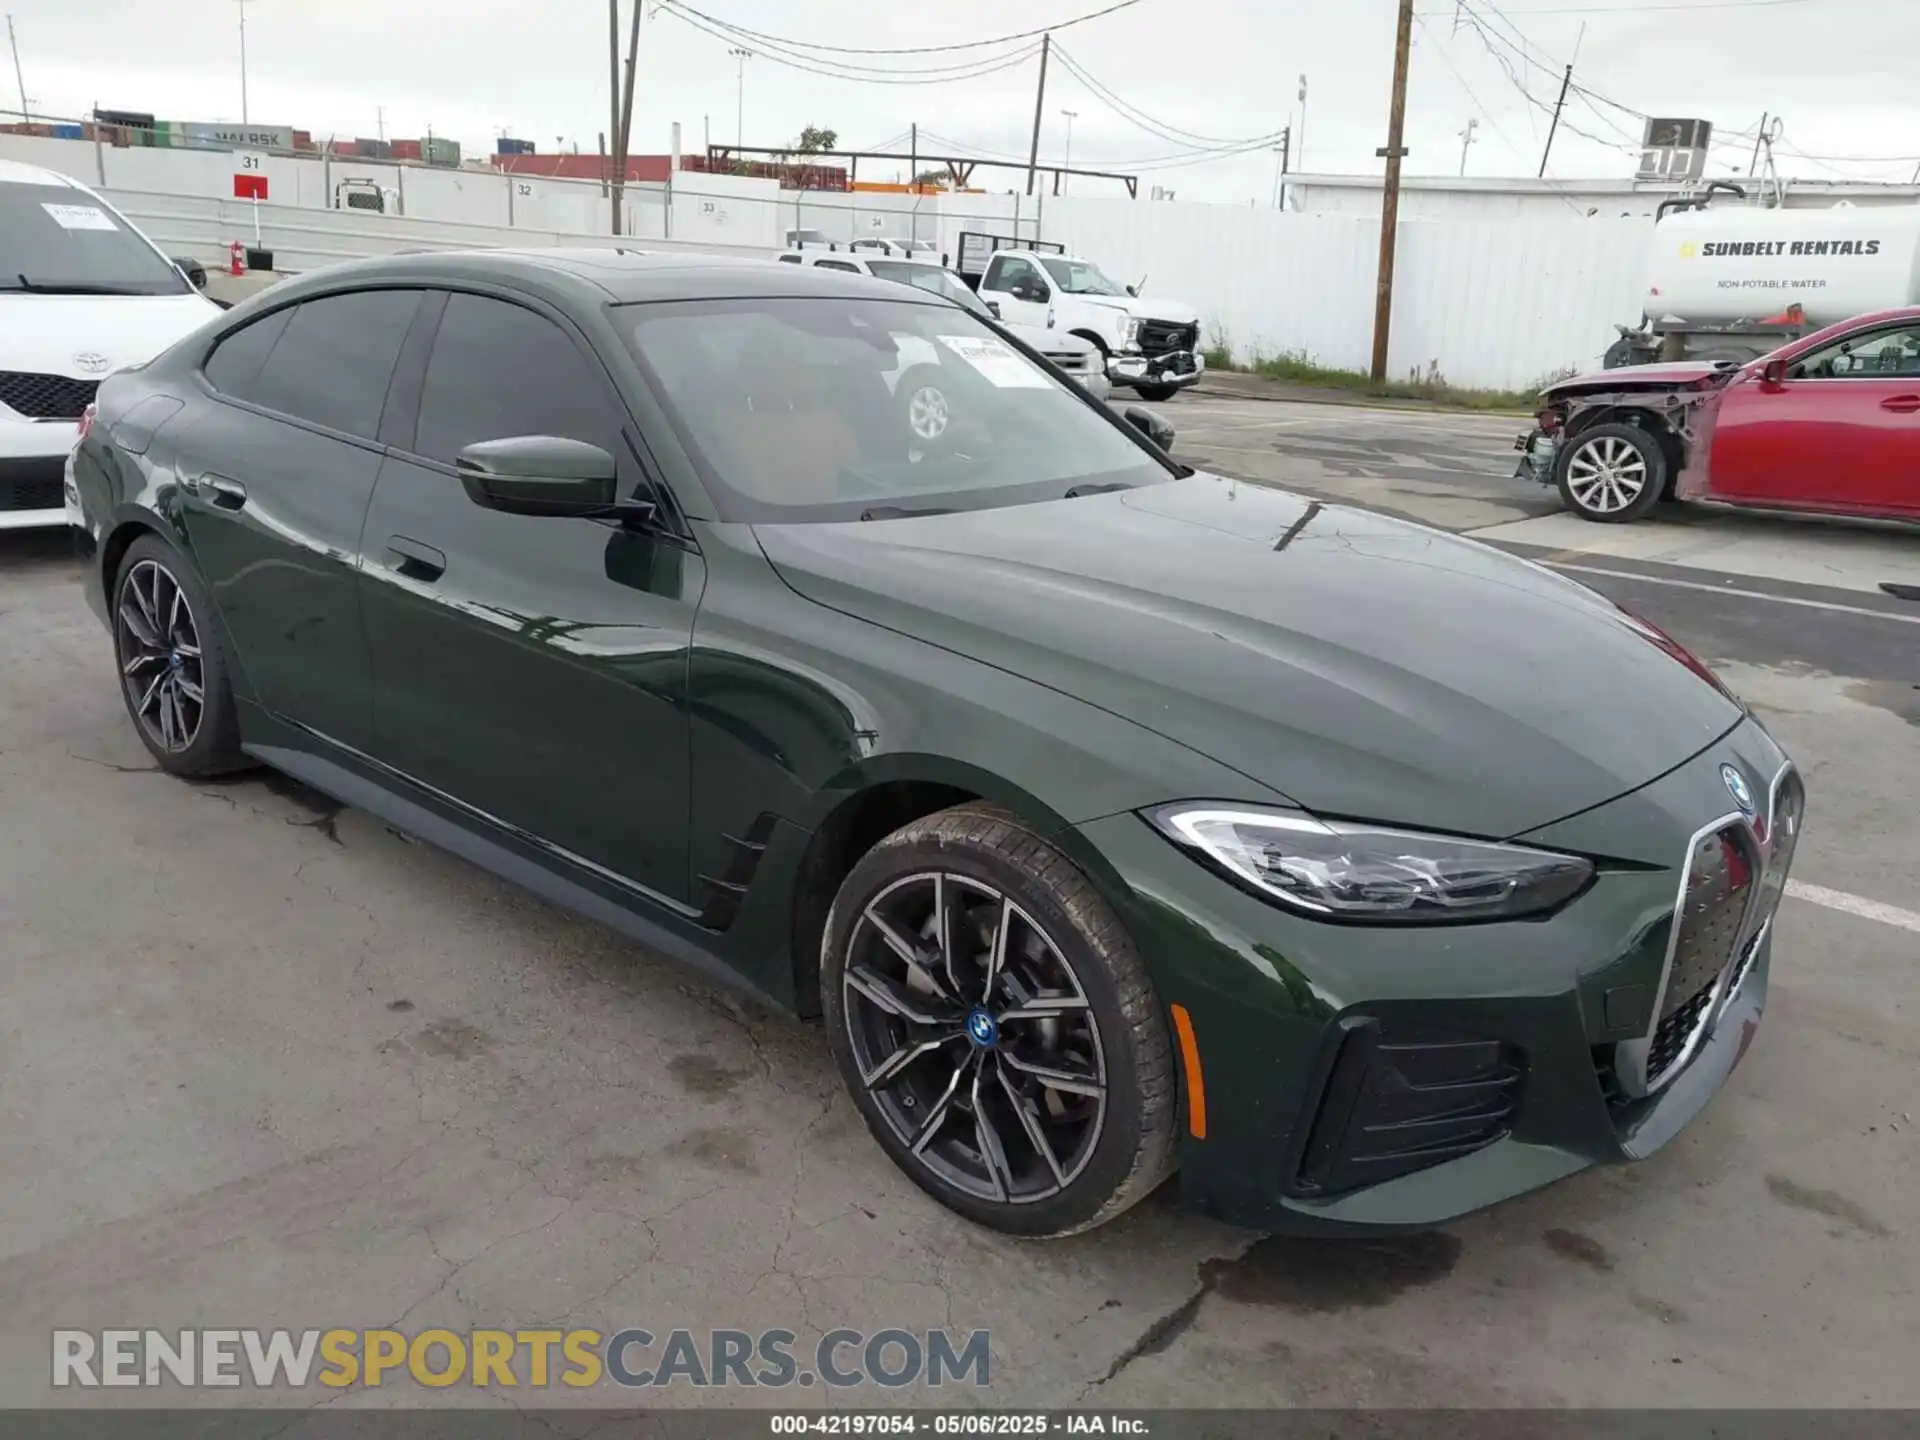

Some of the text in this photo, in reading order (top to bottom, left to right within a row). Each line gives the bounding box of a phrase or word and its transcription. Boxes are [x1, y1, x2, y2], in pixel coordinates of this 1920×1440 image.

[243, 155, 259, 169] 31
[518, 183, 532, 196] 32
[1702, 240, 1881, 257] SUNBELT RENTALS
[1717, 279, 1827, 289] NON-POTABLE WATER
